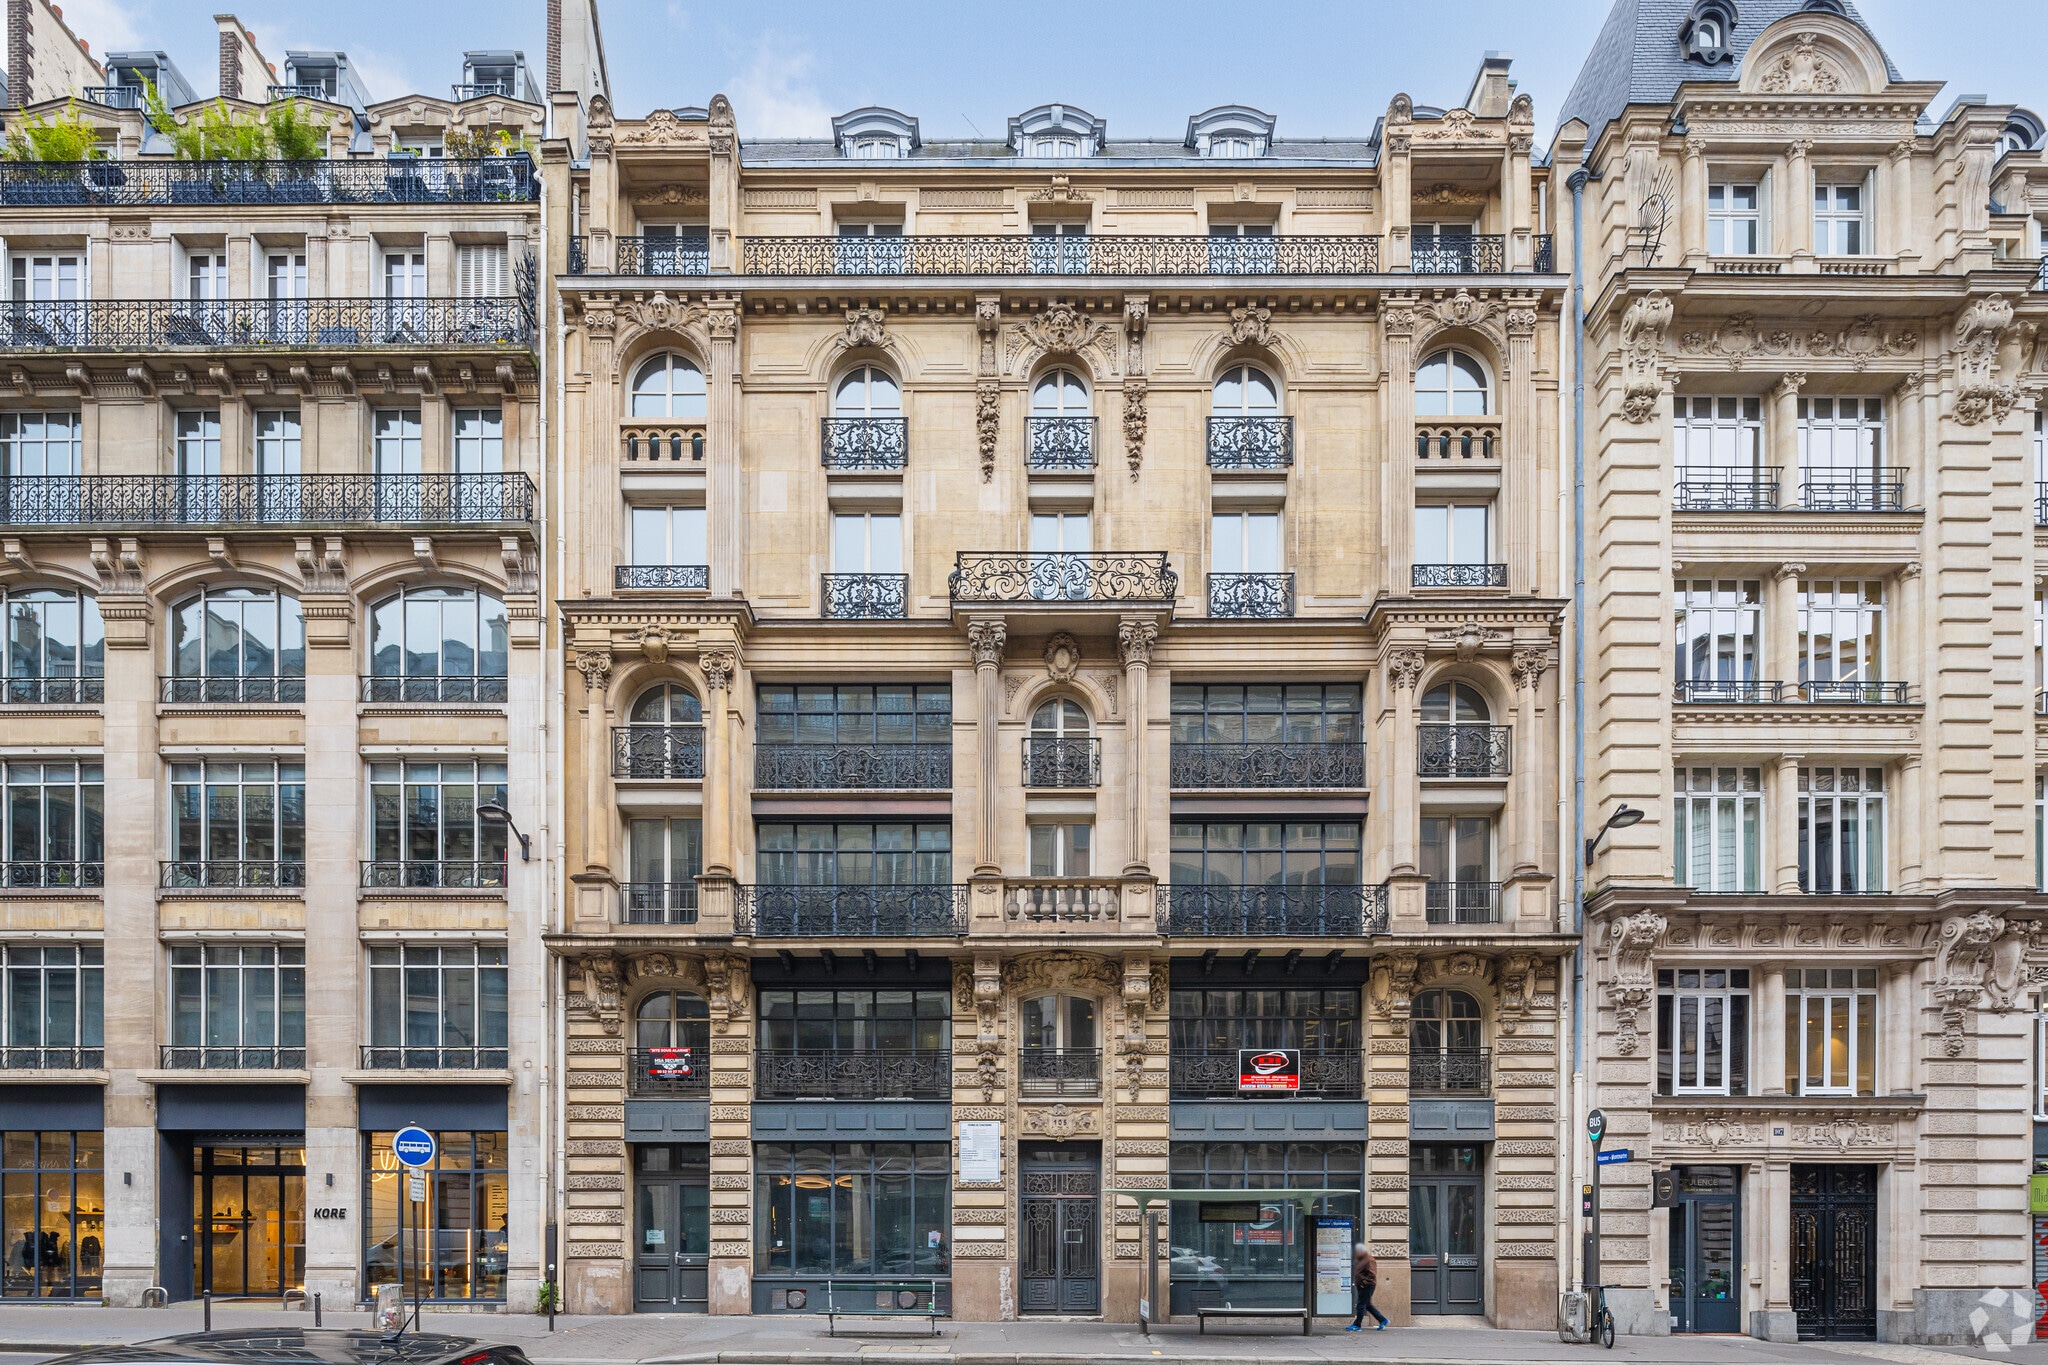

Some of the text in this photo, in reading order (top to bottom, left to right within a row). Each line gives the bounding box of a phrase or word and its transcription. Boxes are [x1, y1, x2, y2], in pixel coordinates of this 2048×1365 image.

[1589, 1116, 1601, 1127] BUS
[1584, 1201, 1591, 1209] 39
[314, 1208, 346, 1218] KORE
